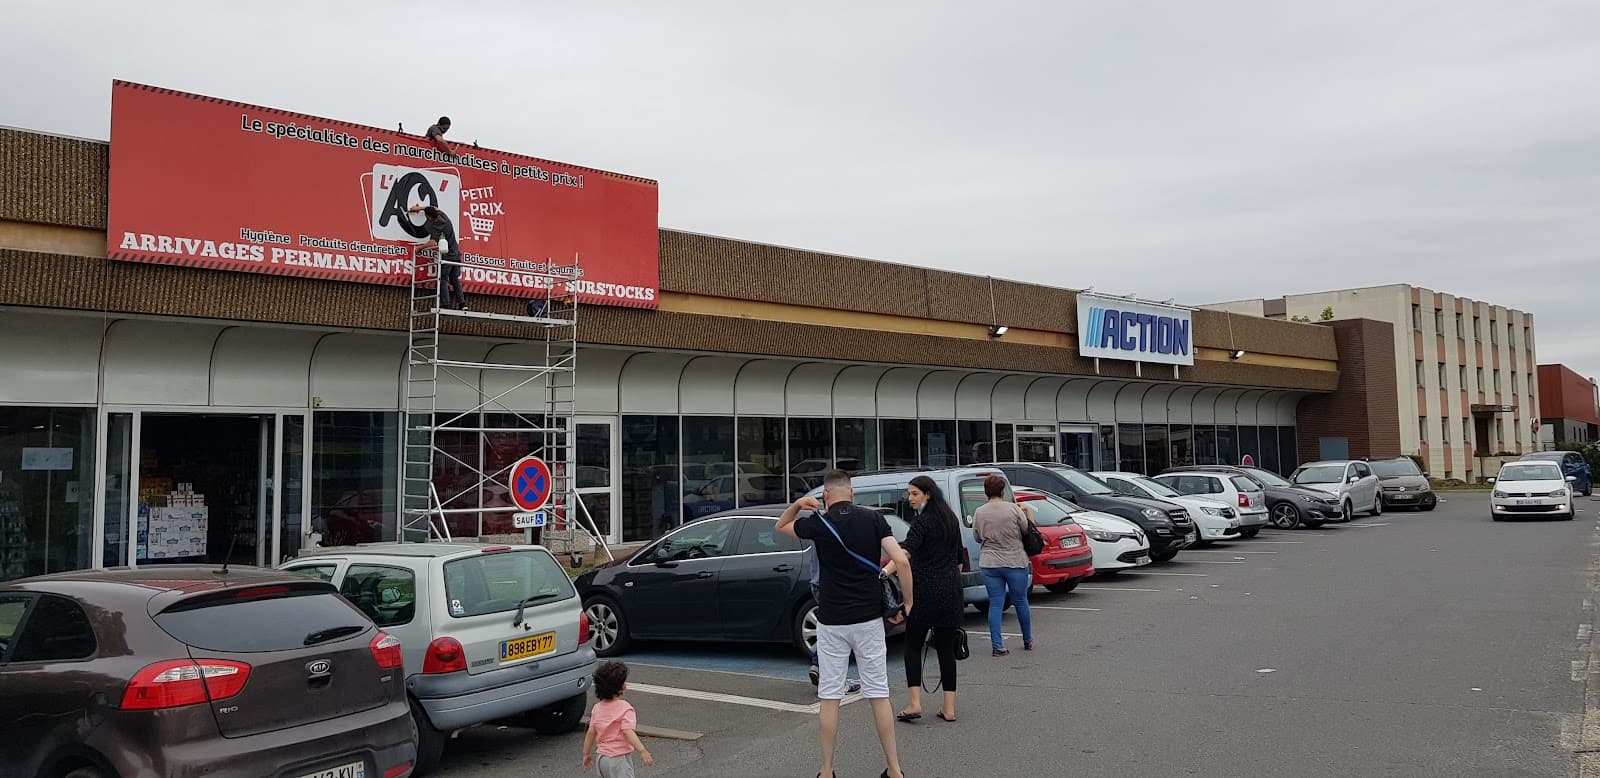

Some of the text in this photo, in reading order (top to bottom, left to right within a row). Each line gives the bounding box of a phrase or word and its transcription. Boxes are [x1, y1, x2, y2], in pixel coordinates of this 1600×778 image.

[241, 114, 263, 132] Le
[266, 122, 359, 148] spécialiste
[362, 136, 390, 154] des
[394, 143, 498, 172] marchandises
[501, 160, 510, 175] à
[512, 165, 549, 181] petits
[461, 186, 494, 201] PETIT
[469, 202, 505, 216] PRIX
[240, 228, 290, 243] Hygiène
[299, 234, 347, 250] Produits
[350, 240, 408, 255] d'entretien
[464, 252, 505, 266] Boissons
[510, 258, 536, 271] Fruits
[120, 232, 654, 301] ARRIVAGES PERMANENTS DTOCKAGES SURSTOCKS
[1101, 309, 1189, 356] ACTION
[516, 515, 534, 525] SAUF
[312, 664, 327, 672] KIA
[219, 705, 239, 714] RIO
